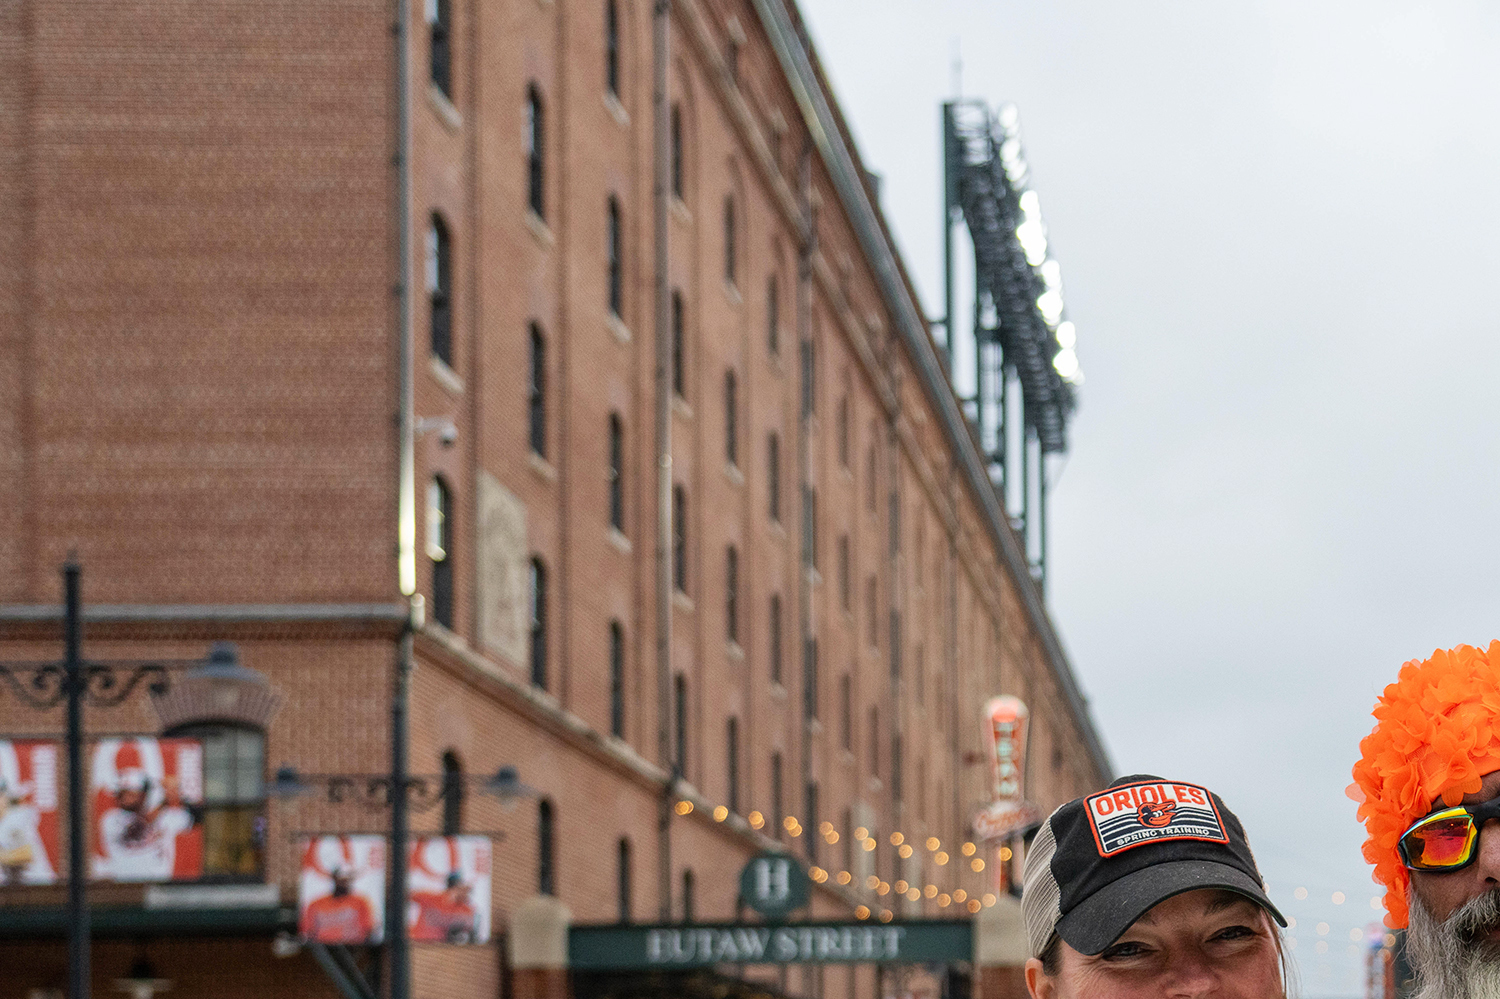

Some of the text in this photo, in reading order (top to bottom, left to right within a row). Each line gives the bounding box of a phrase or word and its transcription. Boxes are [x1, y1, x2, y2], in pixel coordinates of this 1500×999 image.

[1095, 784, 1206, 816] ORIOLES
[1116, 826, 1210, 846] SPRING TRAINING
[646, 926, 903, 963] EUTAW STREET
